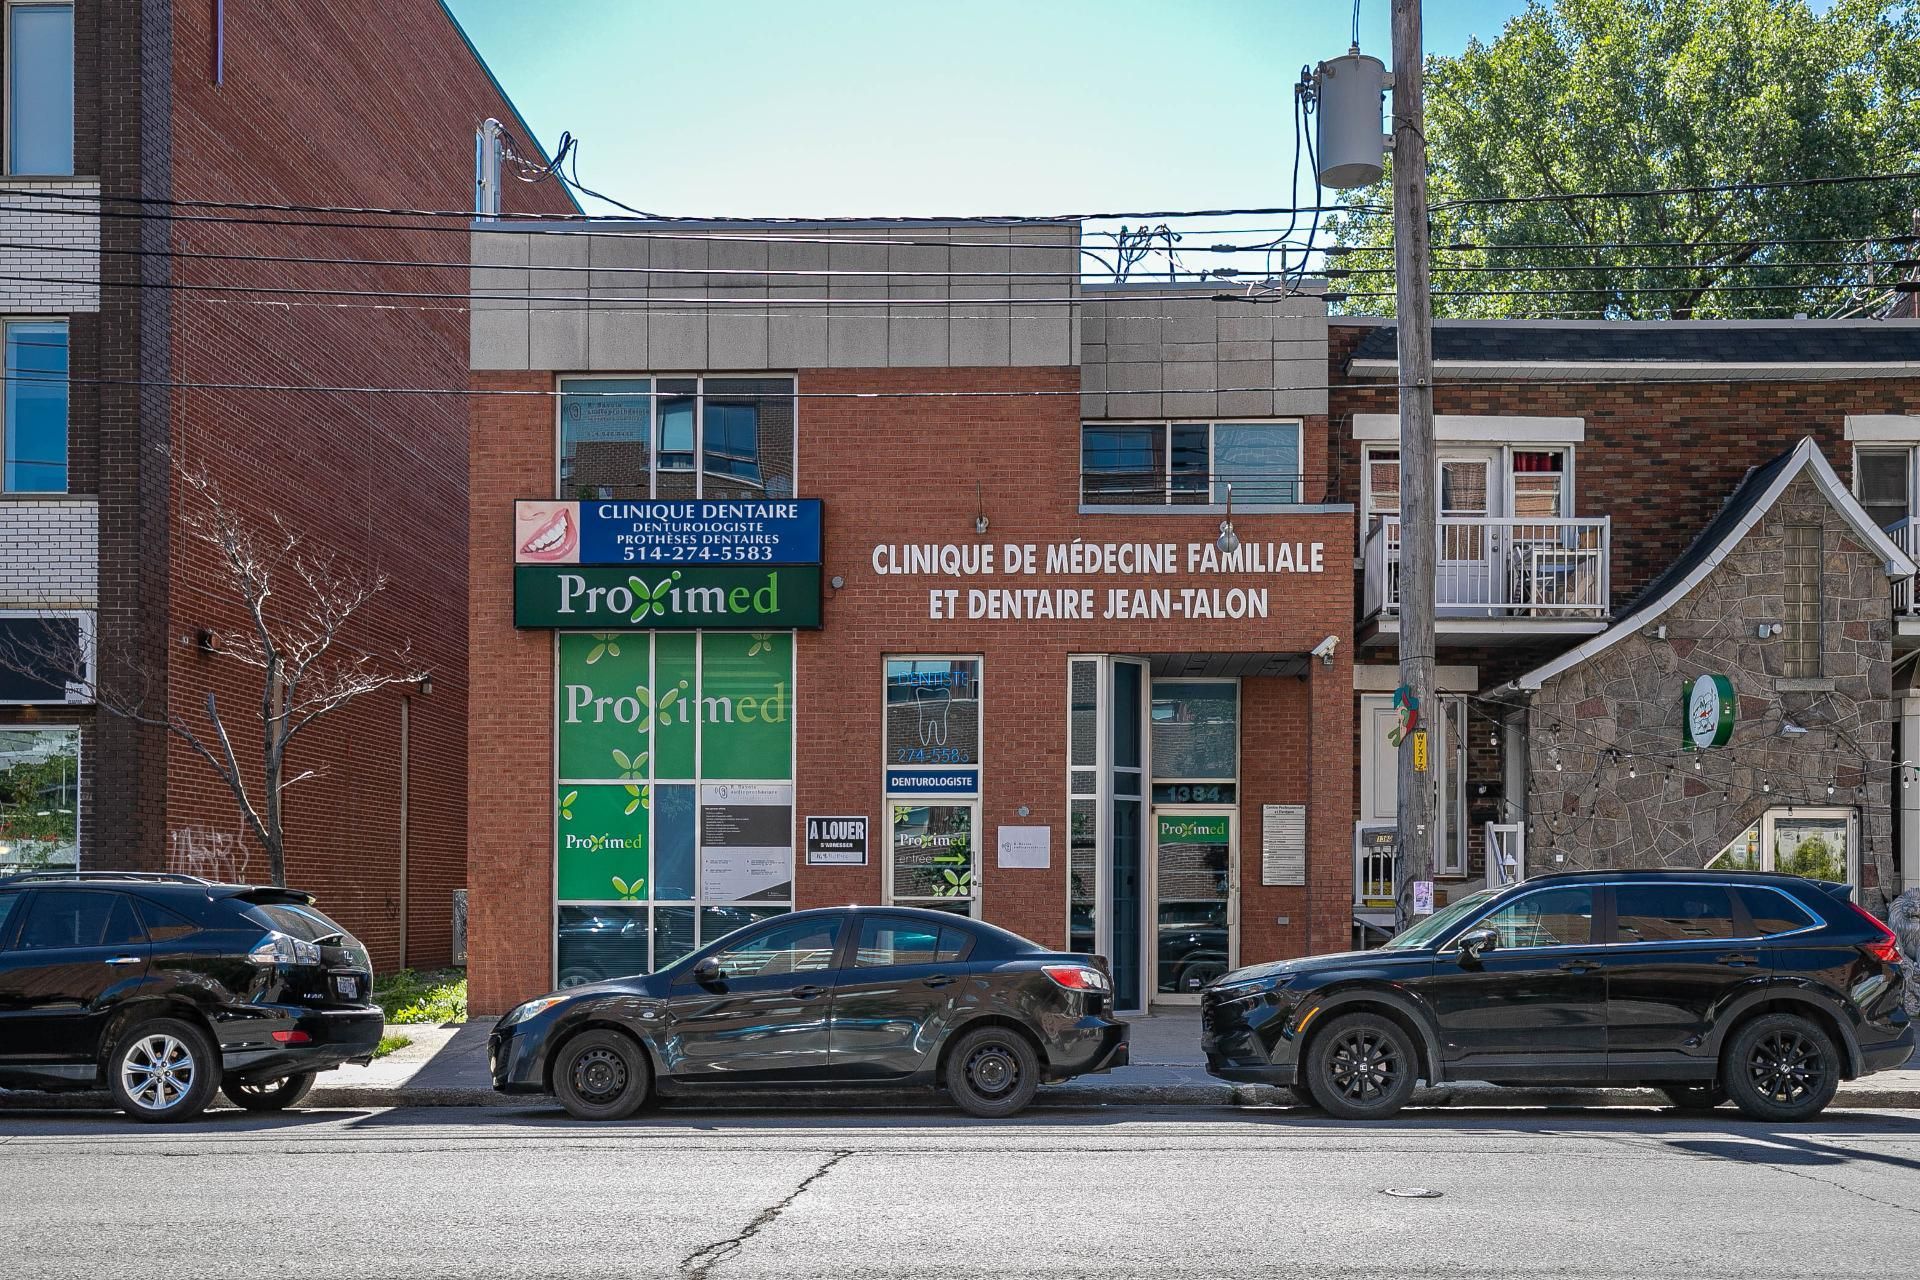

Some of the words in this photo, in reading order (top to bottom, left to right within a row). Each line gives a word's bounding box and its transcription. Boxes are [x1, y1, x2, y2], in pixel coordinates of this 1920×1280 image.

[598, 504, 695, 521] CLINIQUE
[702, 504, 798, 519] DENTAIRE
[633, 522, 764, 532] DENTUROLOGISTE
[617, 532, 697, 544] PROTHÈSES
[703, 534, 779, 544] DENTAIRES
[623, 546, 773, 561] 514-274-5583
[872, 543, 994, 577] CLINIQUE
[1004, 543, 1037, 574] DE
[1045, 538, 1177, 574] MÉDECINE
[1187, 542, 1324, 573] FAMILIALE
[557, 570, 781, 624] Proximed
[930, 589, 958, 619] ET
[968, 589, 1094, 619] DENTAIRE
[1103, 588, 1269, 619] JEAN-TALON
[897, 671, 969, 687] DENTISTE
[564, 679, 787, 734] Proximed
[891, 776, 973, 787] DENTUROLOGISTE
[1167, 785, 1220, 802] 1384
[809, 820, 819, 840] A
[822, 820, 864, 840] LOUER
[1160, 821, 1225, 838] Proximed
[566, 832, 642, 853] Proximed
[900, 832, 967, 849] Proximed
[899, 853, 932, 864] entrée
